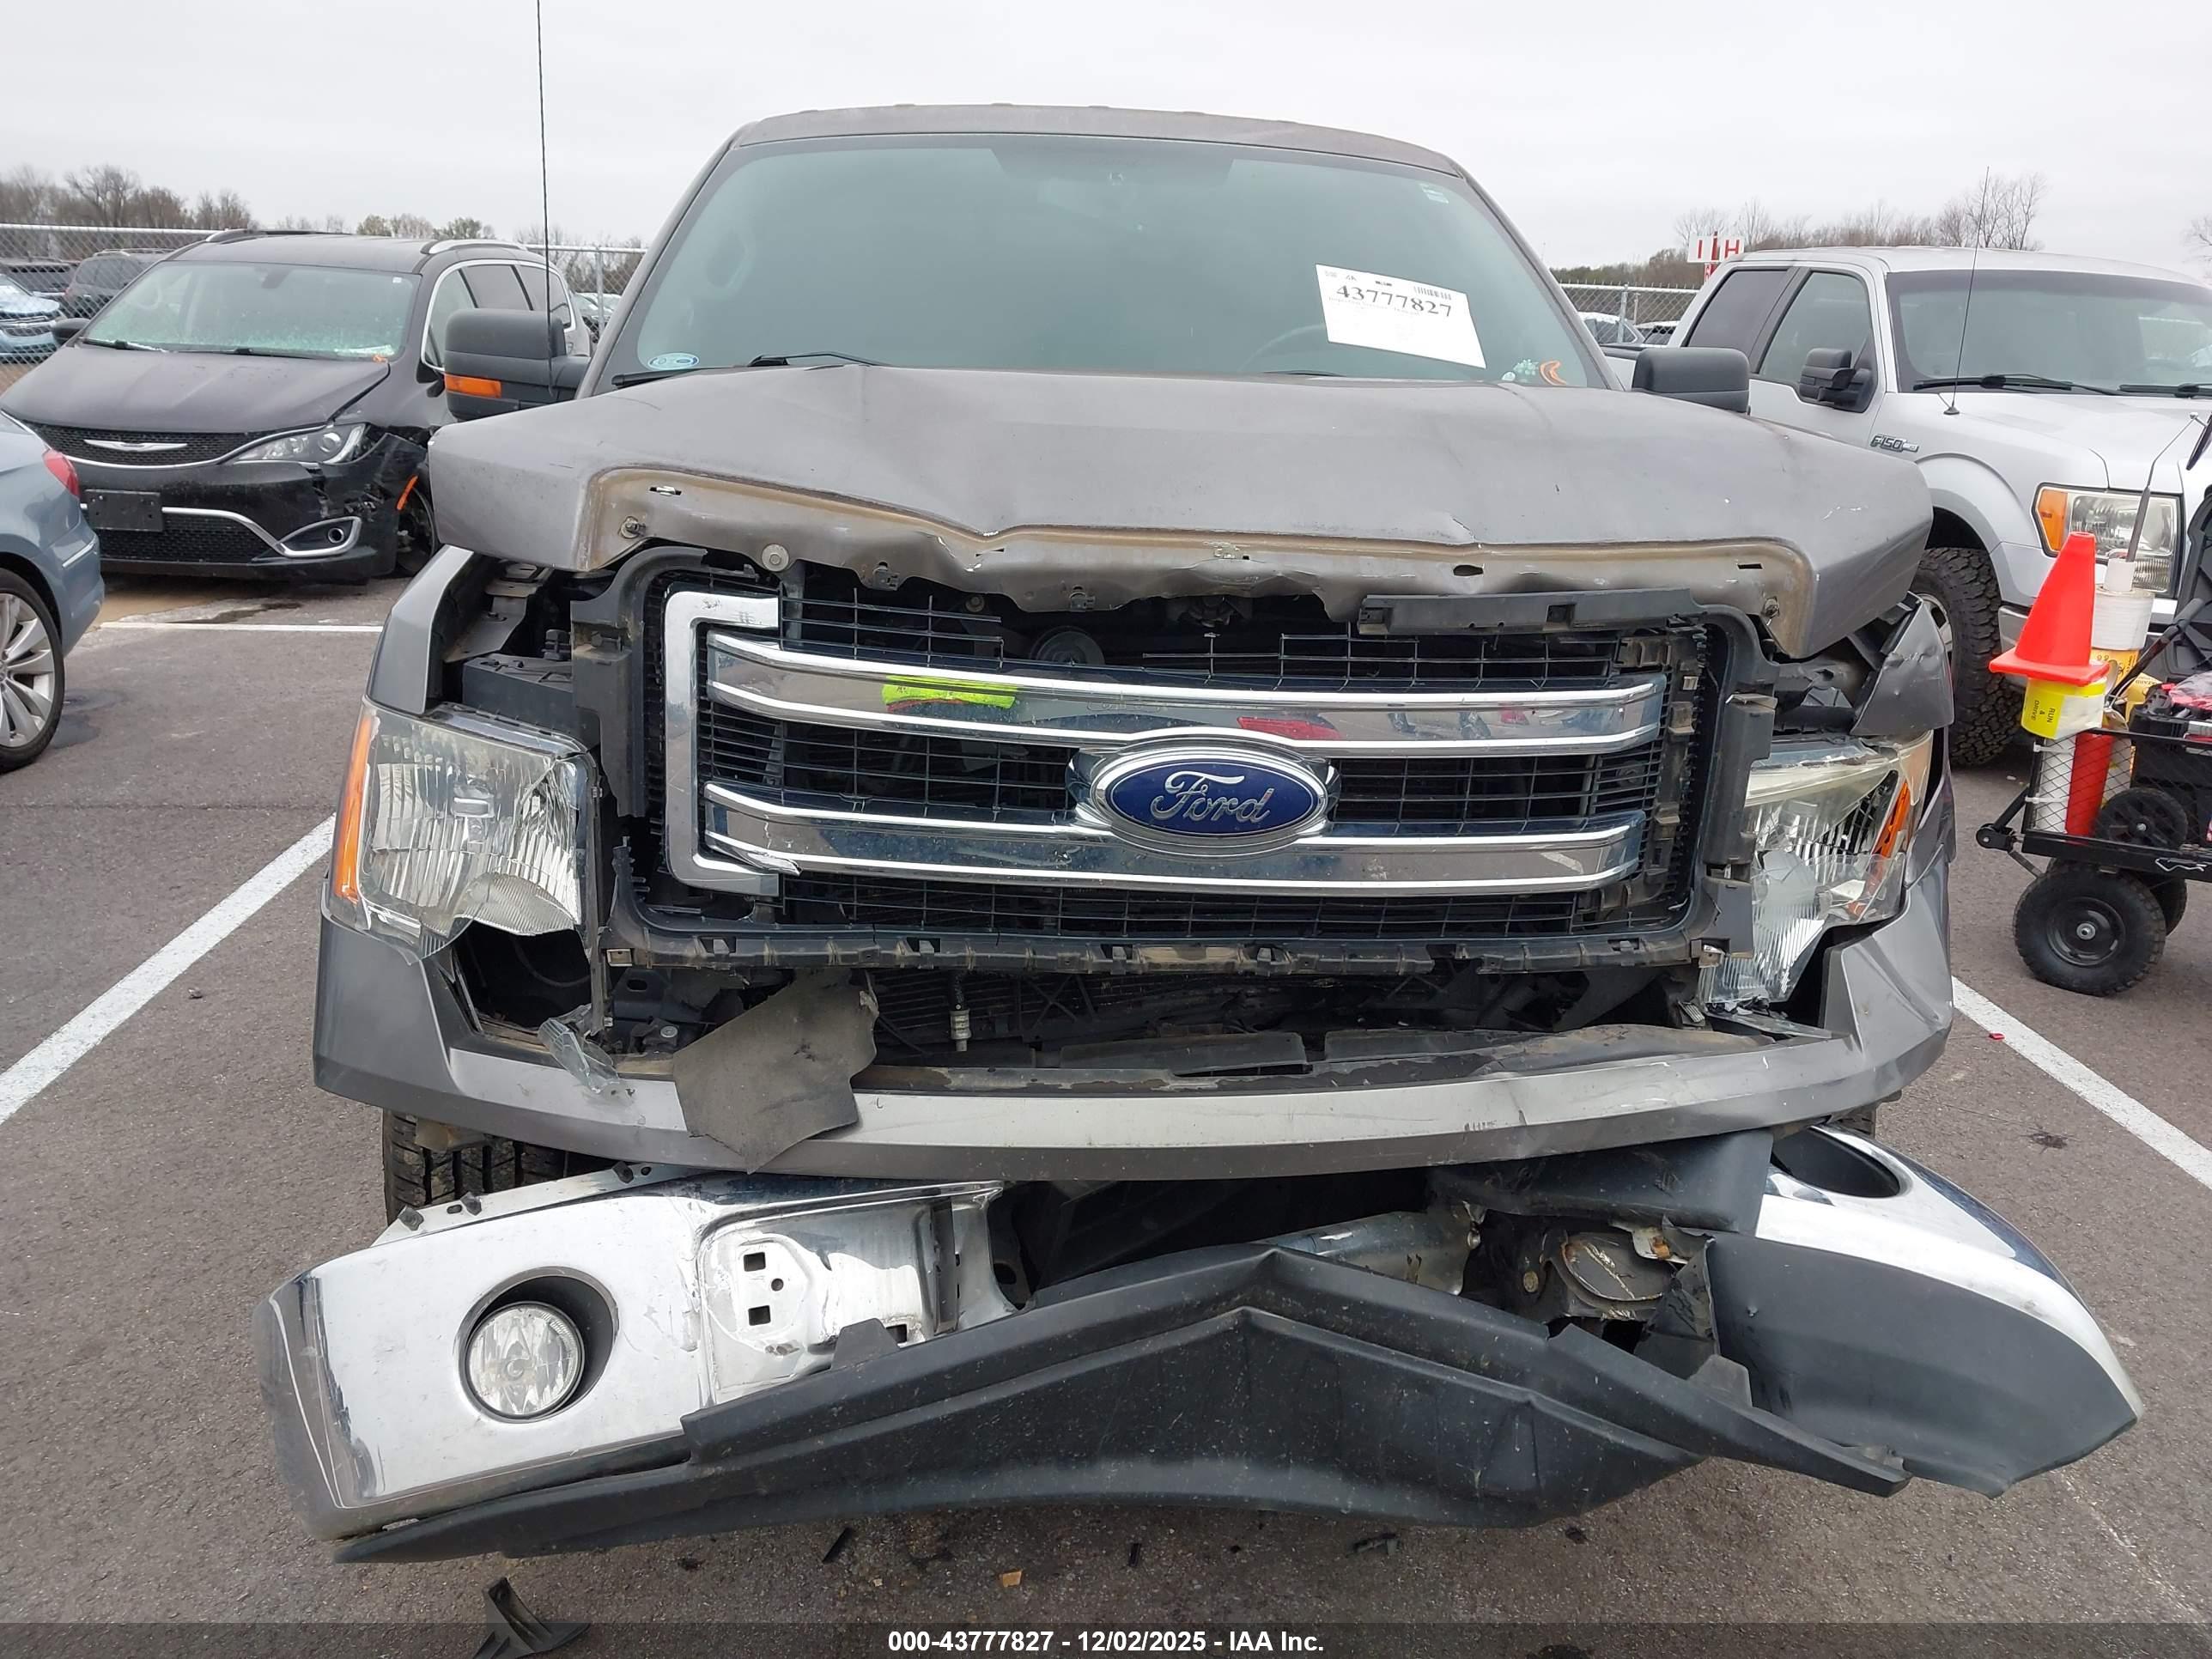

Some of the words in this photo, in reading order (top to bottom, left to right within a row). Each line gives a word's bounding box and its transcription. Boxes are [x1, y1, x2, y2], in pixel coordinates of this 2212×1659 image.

[1336, 285, 1452, 317] 43777827
[2046, 708, 2056, 723] RUN
[1150, 770, 1275, 823] Ford
